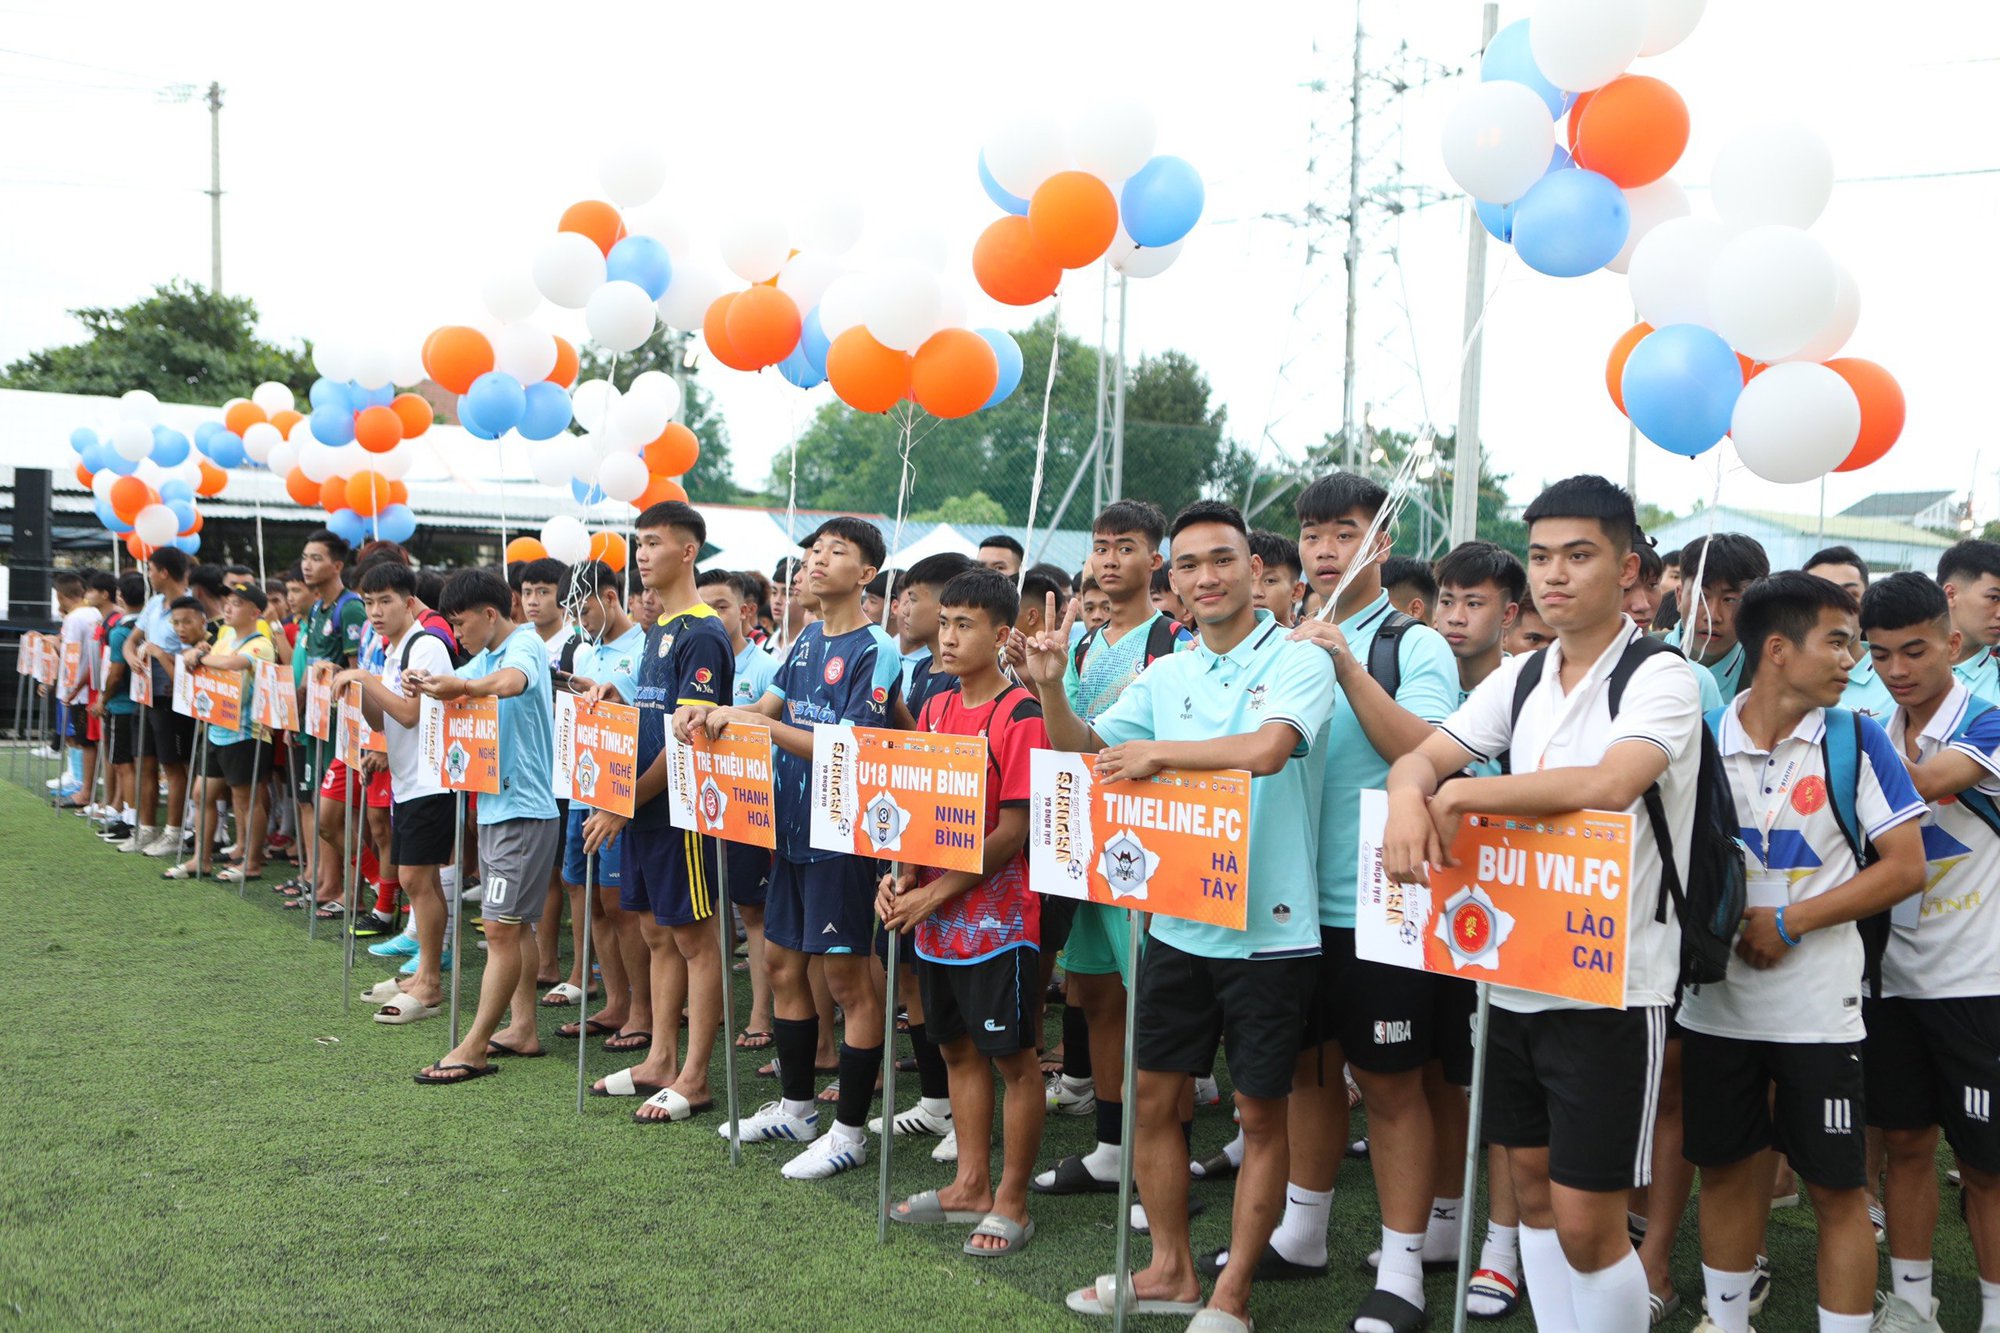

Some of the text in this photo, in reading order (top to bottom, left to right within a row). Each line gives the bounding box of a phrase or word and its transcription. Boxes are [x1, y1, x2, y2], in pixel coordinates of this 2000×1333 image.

[449, 714, 474, 742] NGHỆ
[576, 722, 599, 752] NGHỆ
[487, 765, 497, 777] AN
[609, 761, 632, 782] NGHỆ
[696, 746, 769, 782] TRẺ THIỆU HOÁ
[858, 761, 979, 798] U18 NINH BÌNH
[732, 787, 769, 807] THANH
[747, 810, 770, 828] HOÁ
[935, 805, 976, 826] NINH
[1043, 808, 1051, 829] BÓNG
[1055, 771, 1073, 863] VSPORTS
[1103, 792, 1242, 842] TIMELINE.FC
[935, 827, 975, 850] BÌNH
[1211, 851, 1238, 874] HÀ
[1478, 836, 1621, 900] BÙI VN.FC
[486, 876, 507, 904] 10
[1200, 877, 1238, 901] TÂY
[1566, 908, 1615, 939] LÀO
[1573, 945, 1613, 973] CAI
[1386, 1020, 1411, 1044] NBA
